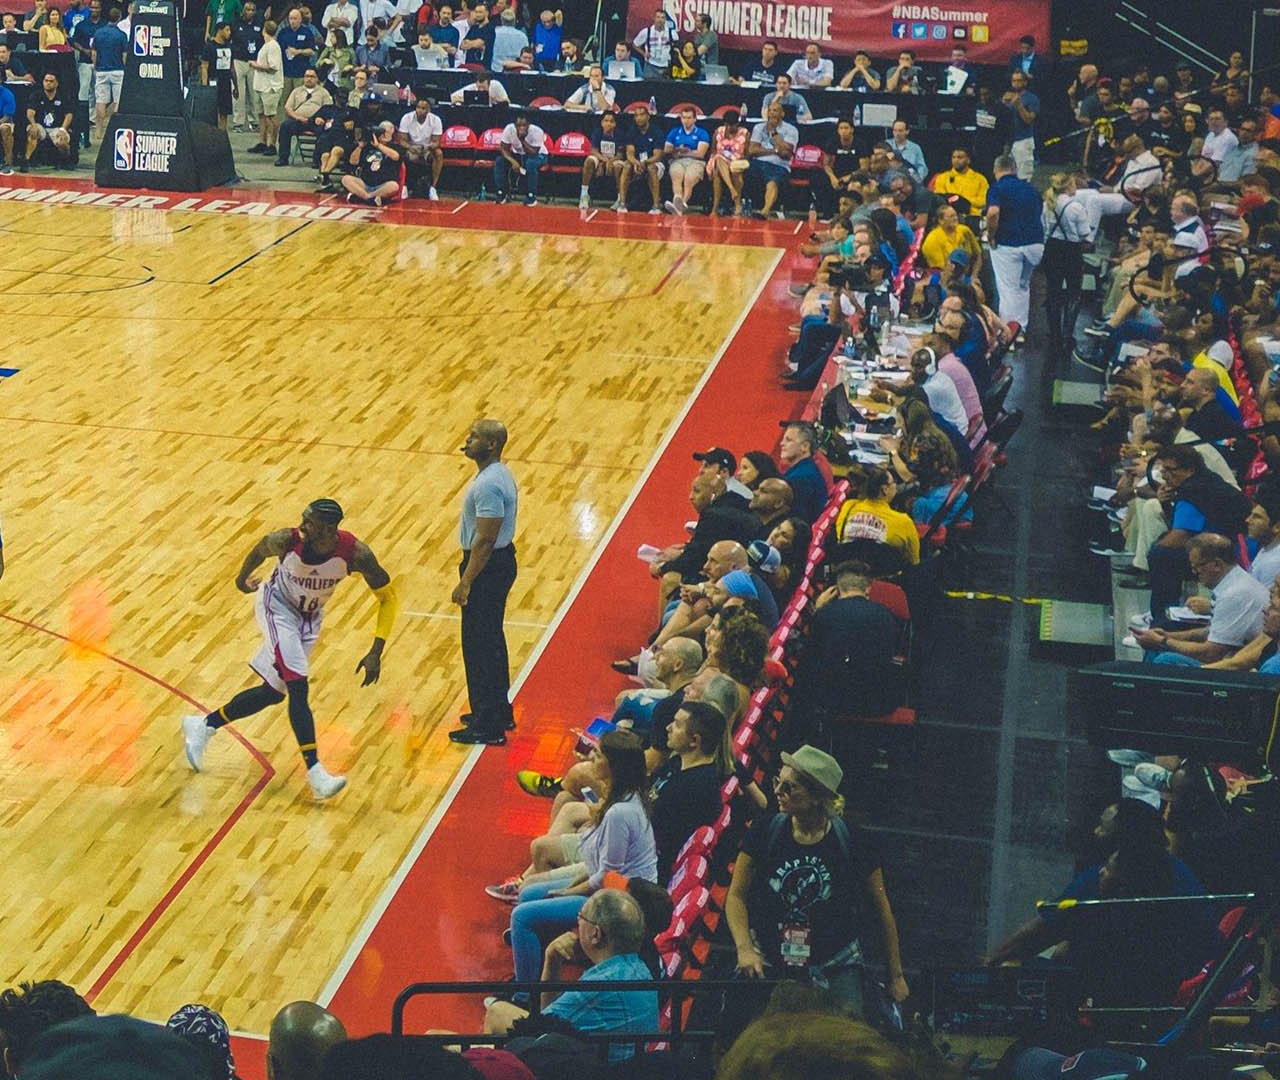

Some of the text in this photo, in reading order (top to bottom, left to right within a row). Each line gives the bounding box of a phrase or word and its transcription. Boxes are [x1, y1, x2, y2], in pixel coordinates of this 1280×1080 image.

[765, 3, 833, 41] LEAGUE
[892, 4, 988, 23] #NBASummer
[139, 63, 164, 80] @NBA
[135, 136, 177, 155] SUMMER
[135, 154, 170, 172] LEAGUE
[171, 198, 384, 222] LEAGUE
